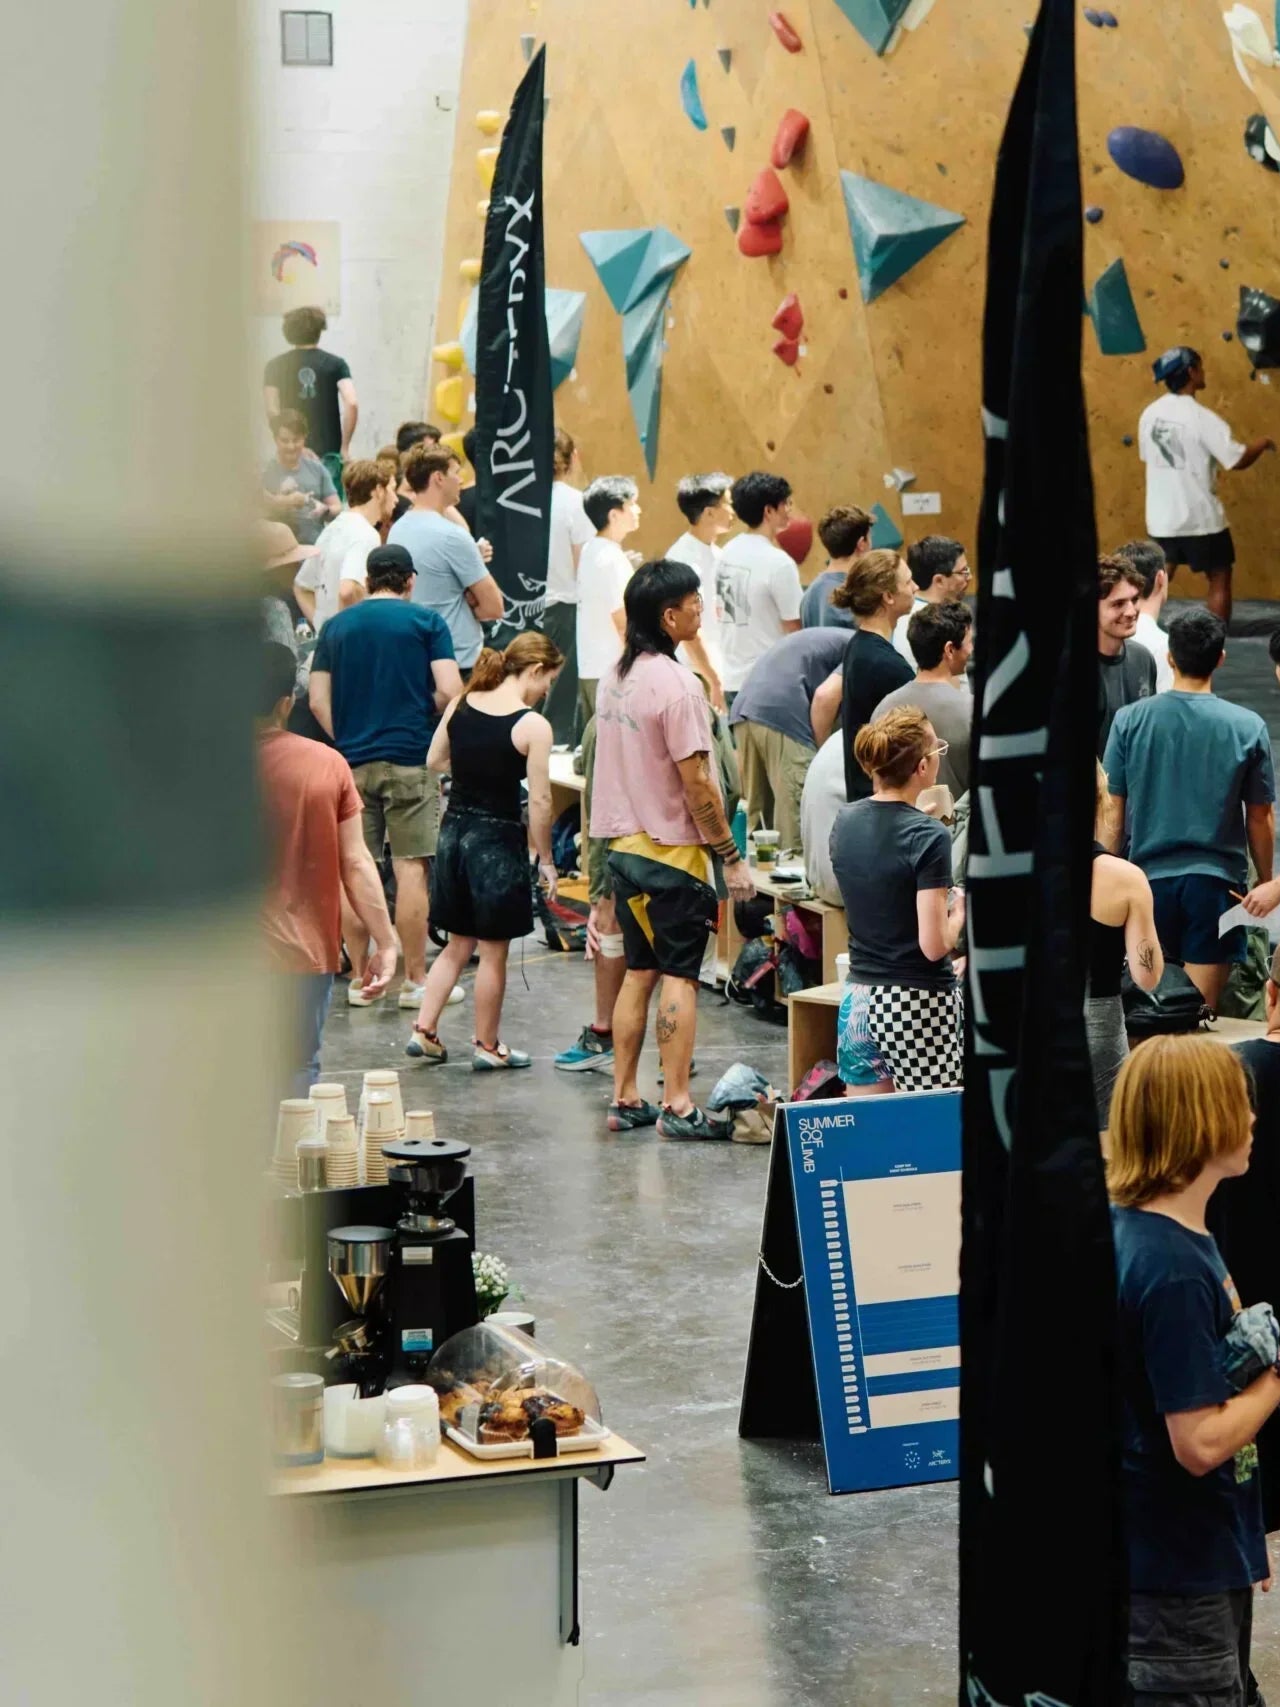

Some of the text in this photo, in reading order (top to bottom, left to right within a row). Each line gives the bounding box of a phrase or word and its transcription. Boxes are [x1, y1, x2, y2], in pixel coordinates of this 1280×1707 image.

[798, 1114, 855, 1131] SUMMER
[811, 1129, 824, 1148] OF
[800, 1130, 816, 1174] CLIMB
